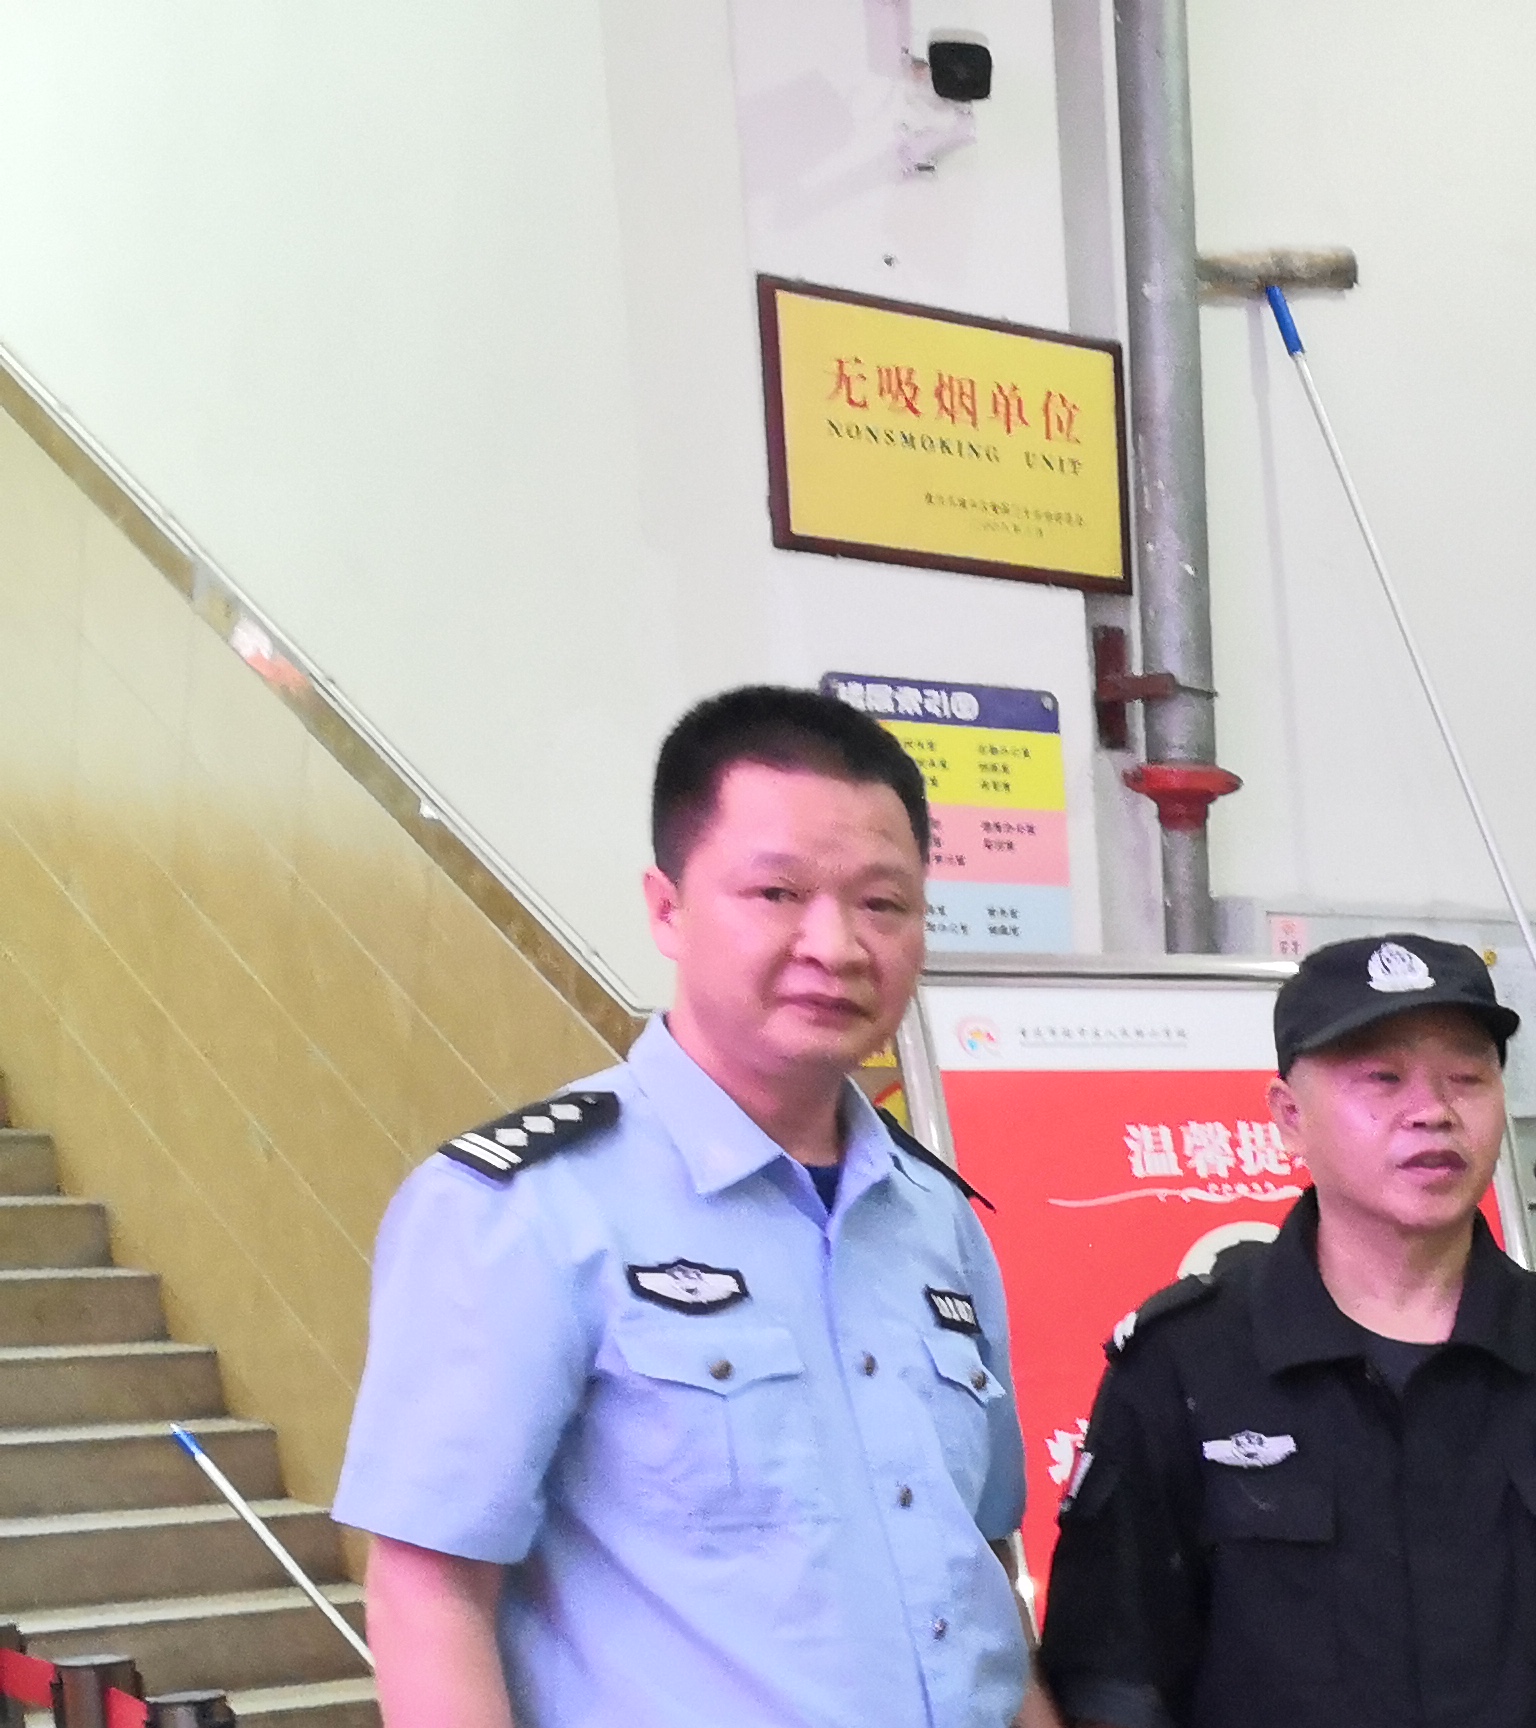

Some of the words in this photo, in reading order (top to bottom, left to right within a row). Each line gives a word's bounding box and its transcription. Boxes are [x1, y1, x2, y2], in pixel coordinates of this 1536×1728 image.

[825, 356, 1082, 445] 无吸烟单位
[826, 418, 1001, 464] NONSMOKING
[1024, 450, 1084, 477] UNIT
[1124, 1119, 1294, 1179] 温馨提
